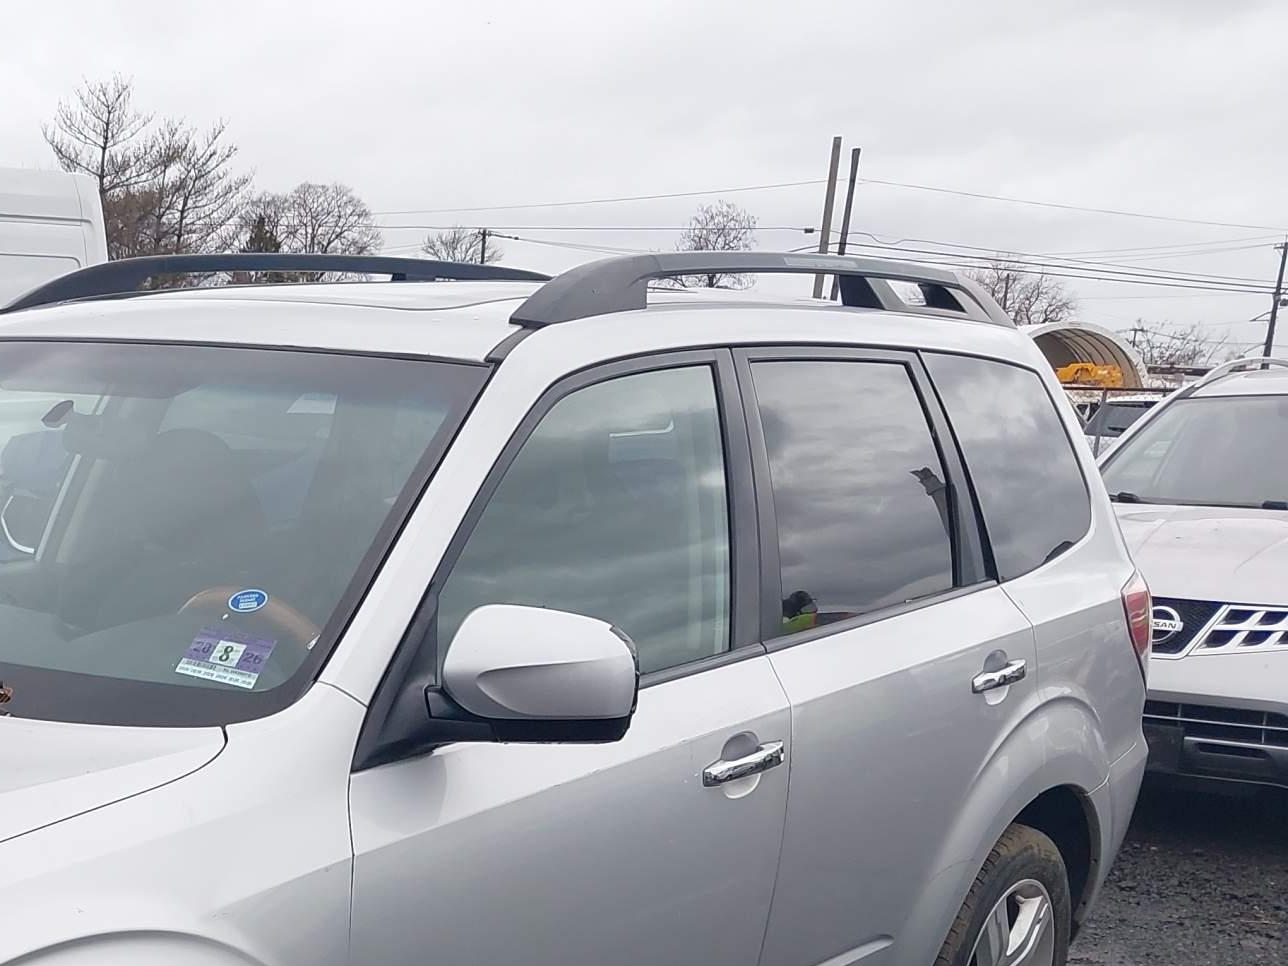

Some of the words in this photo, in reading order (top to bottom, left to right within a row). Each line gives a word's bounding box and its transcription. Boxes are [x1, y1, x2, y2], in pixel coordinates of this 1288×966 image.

[1153, 621, 1177, 629] SAN
[218, 645, 234, 662] 8
[243, 652, 262, 665] 26
